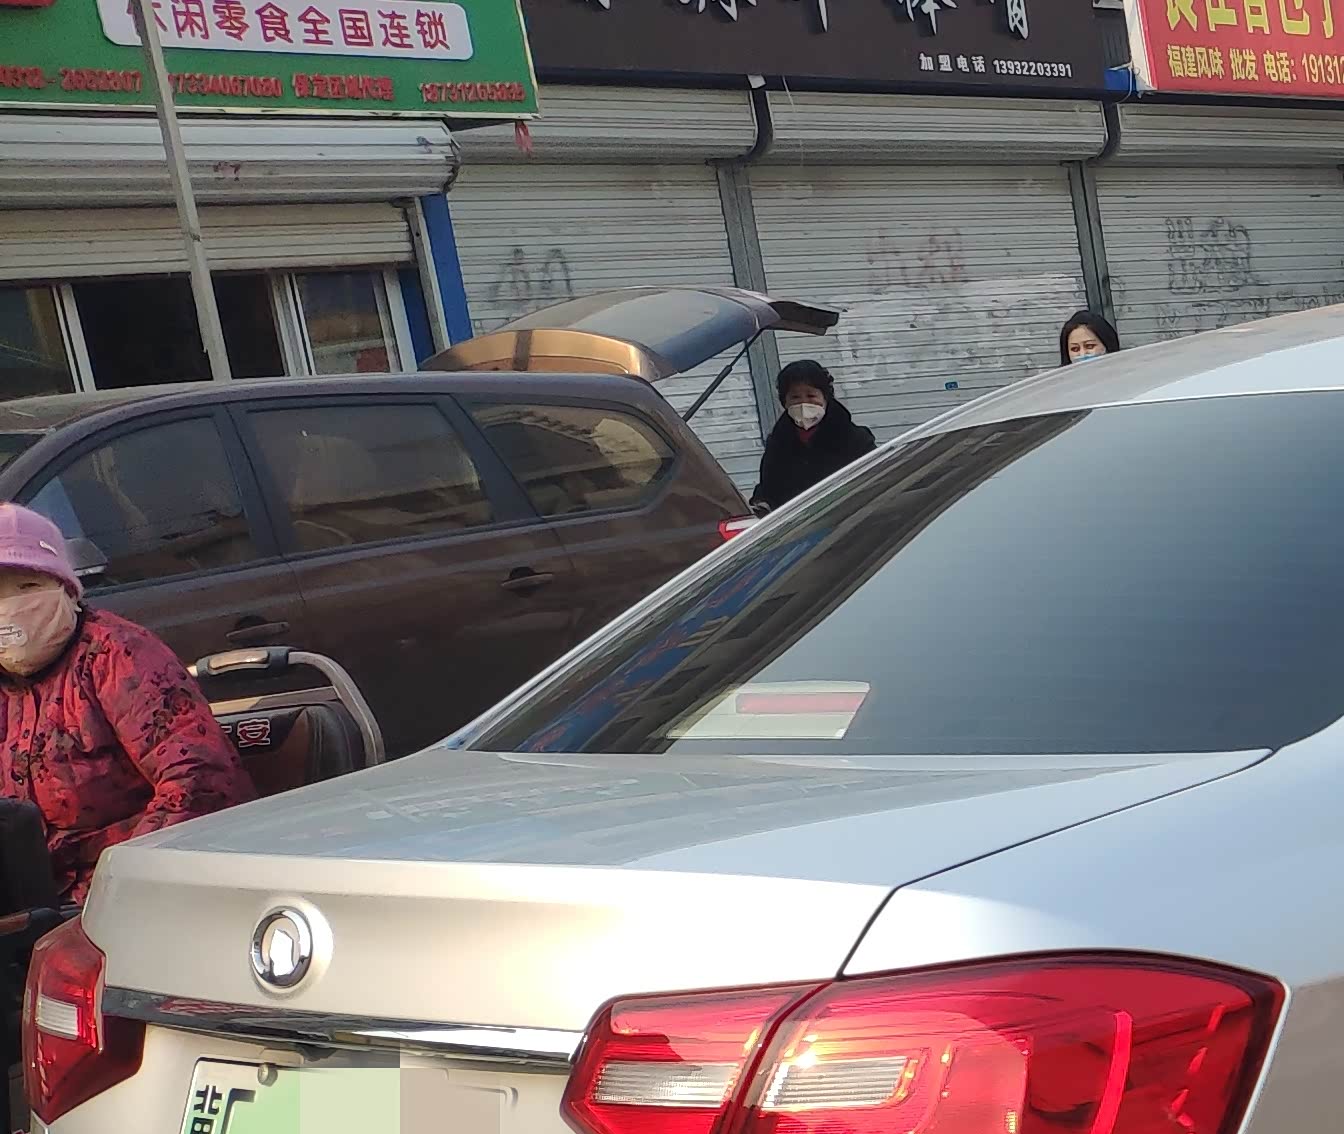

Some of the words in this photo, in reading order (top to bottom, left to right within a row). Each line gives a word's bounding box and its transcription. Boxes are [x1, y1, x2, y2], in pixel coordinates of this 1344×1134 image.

[919, 53, 986, 73] 加盟电话
[993, 59, 1073, 78] 13932203391
[1167, 44, 1225, 80] 福建风味
[1230, 47, 1259, 82] 批发
